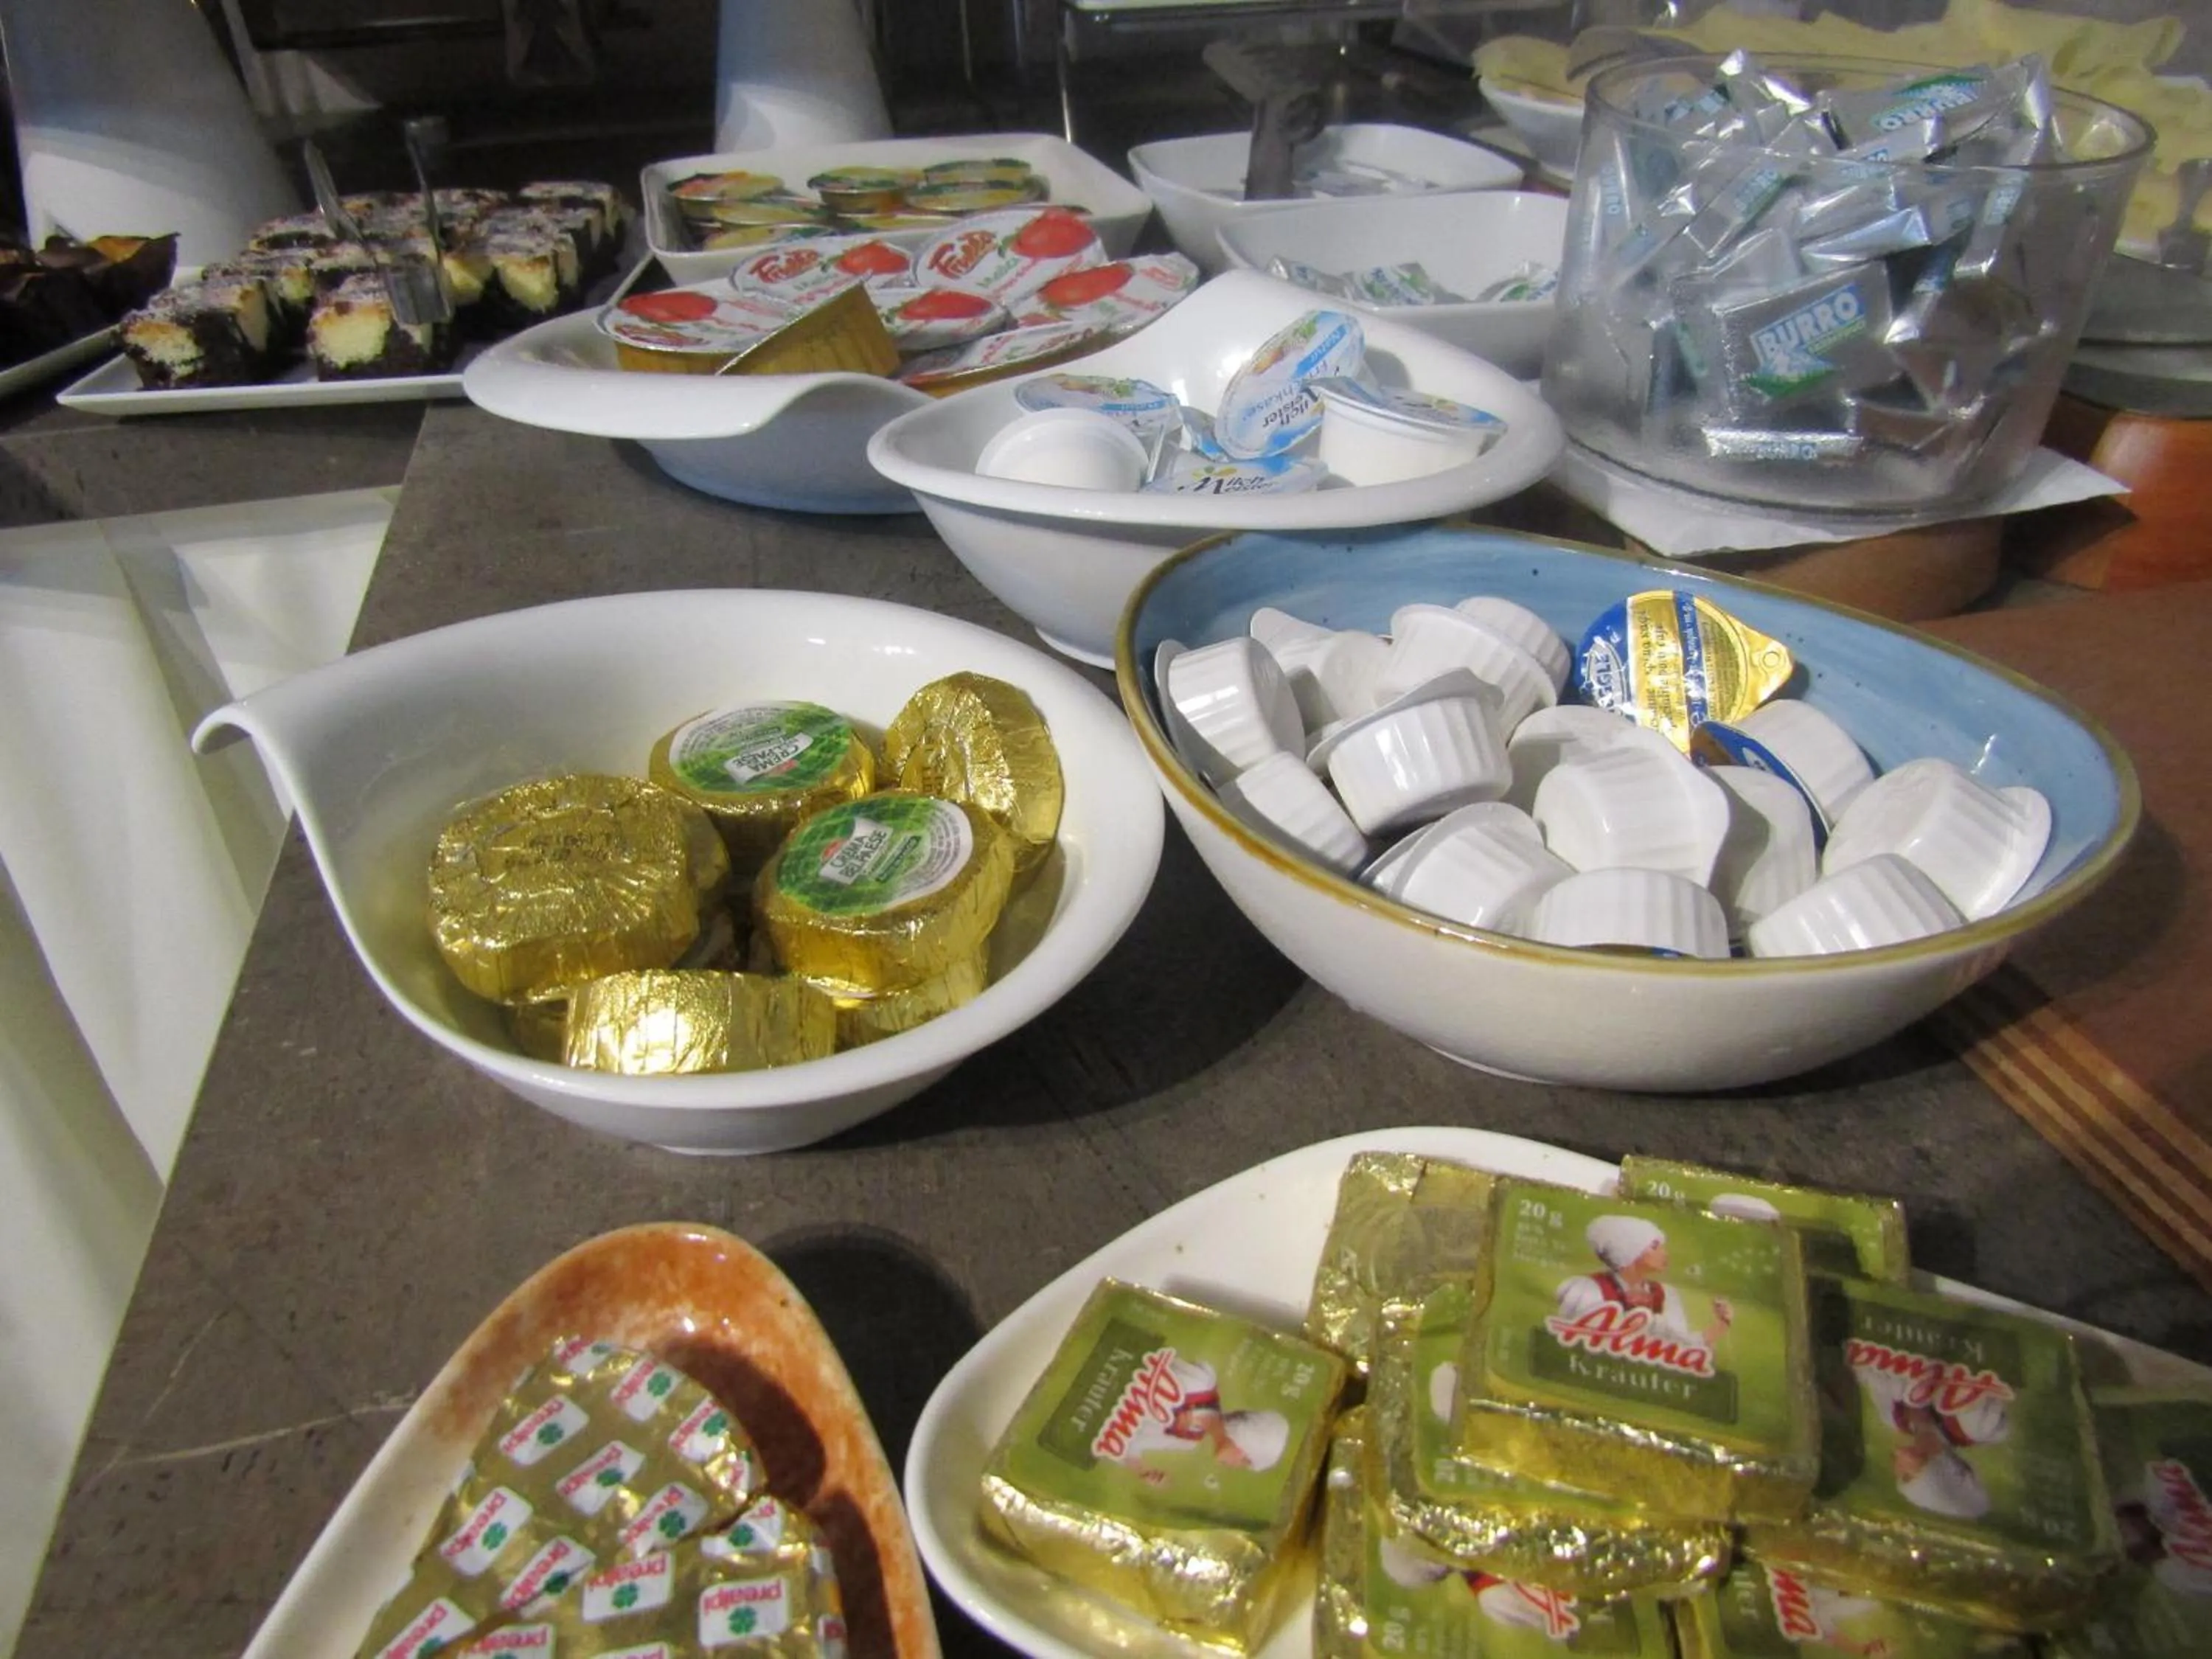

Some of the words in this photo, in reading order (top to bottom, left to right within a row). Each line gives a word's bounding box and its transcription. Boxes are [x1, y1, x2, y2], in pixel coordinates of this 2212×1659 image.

[1757, 291, 1859, 362] BURRO
[830, 835, 870, 869] CREMA
[1519, 1199, 1546, 1218] 20
[1647, 1180, 1672, 1200] 20
[1545, 1301, 1715, 1377] Alma
[1092, 1348, 1183, 1458] Alma
[1846, 1338, 2015, 1416] Alma
